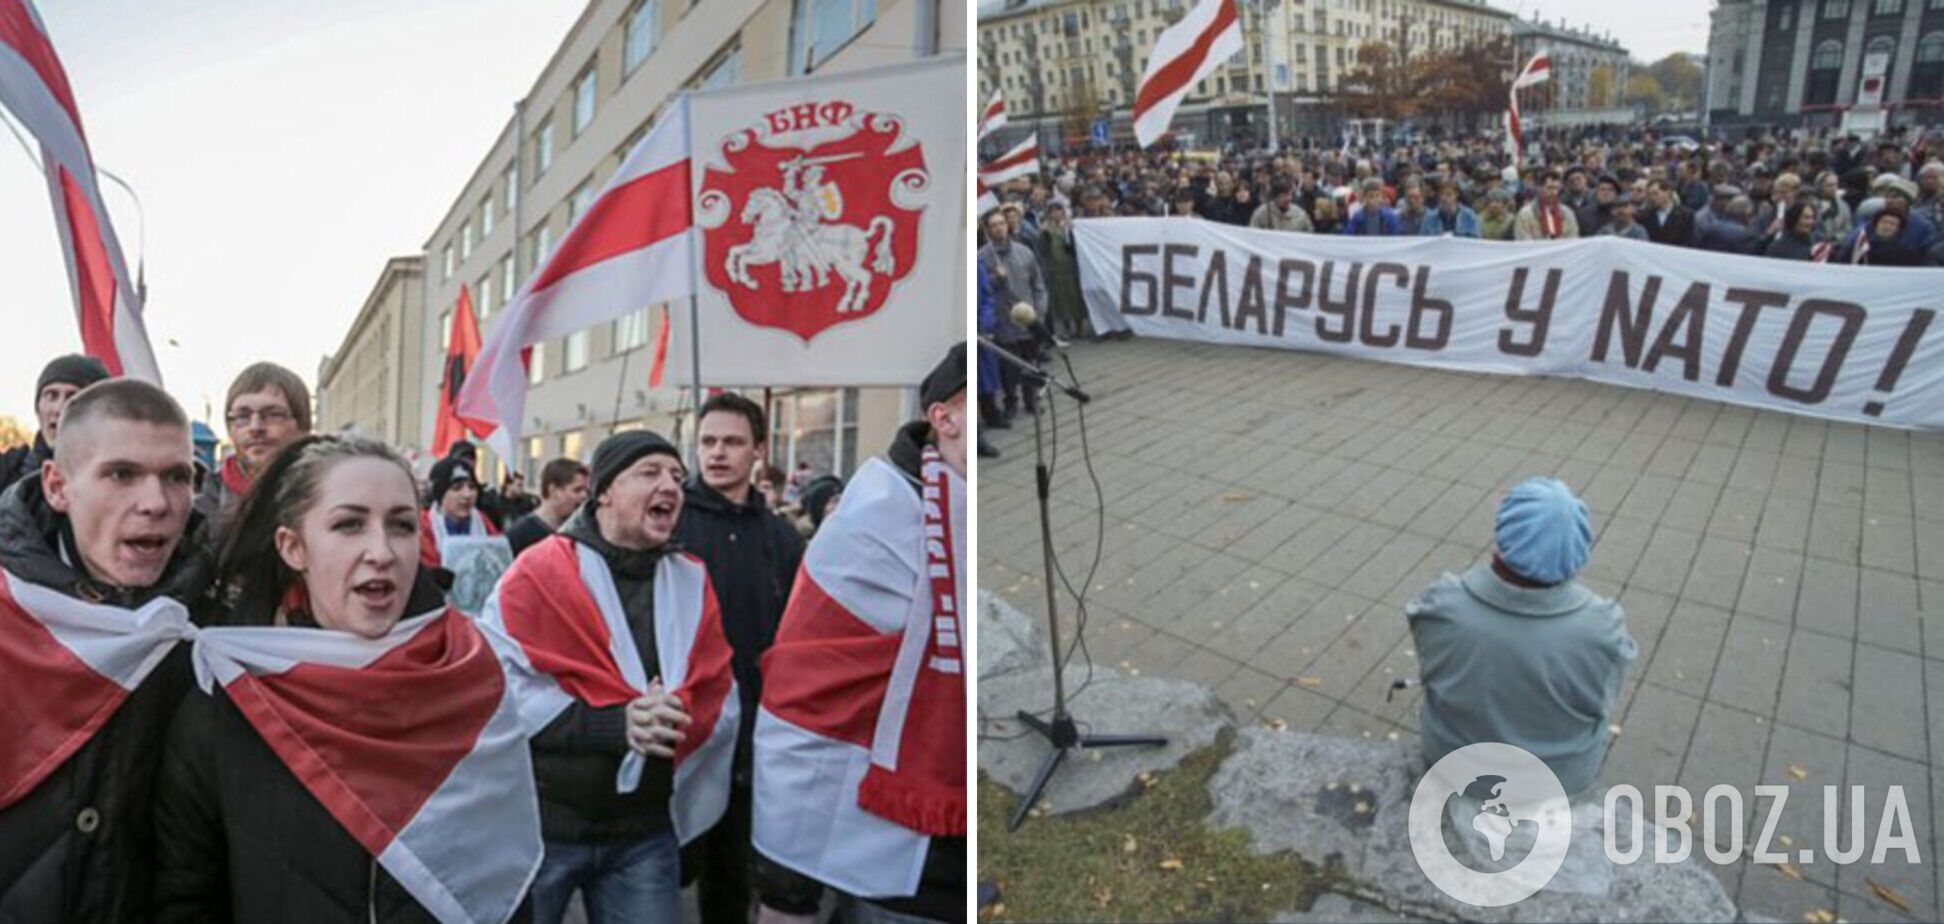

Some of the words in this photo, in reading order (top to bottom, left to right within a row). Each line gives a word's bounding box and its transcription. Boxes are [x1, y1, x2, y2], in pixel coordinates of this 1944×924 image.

[764, 101, 853, 134] БНФ
[1120, 243, 1454, 351] БЕЛАРУСЬ
[1497, 267, 1563, 358] У
[1590, 270, 1936, 417] NATO!
